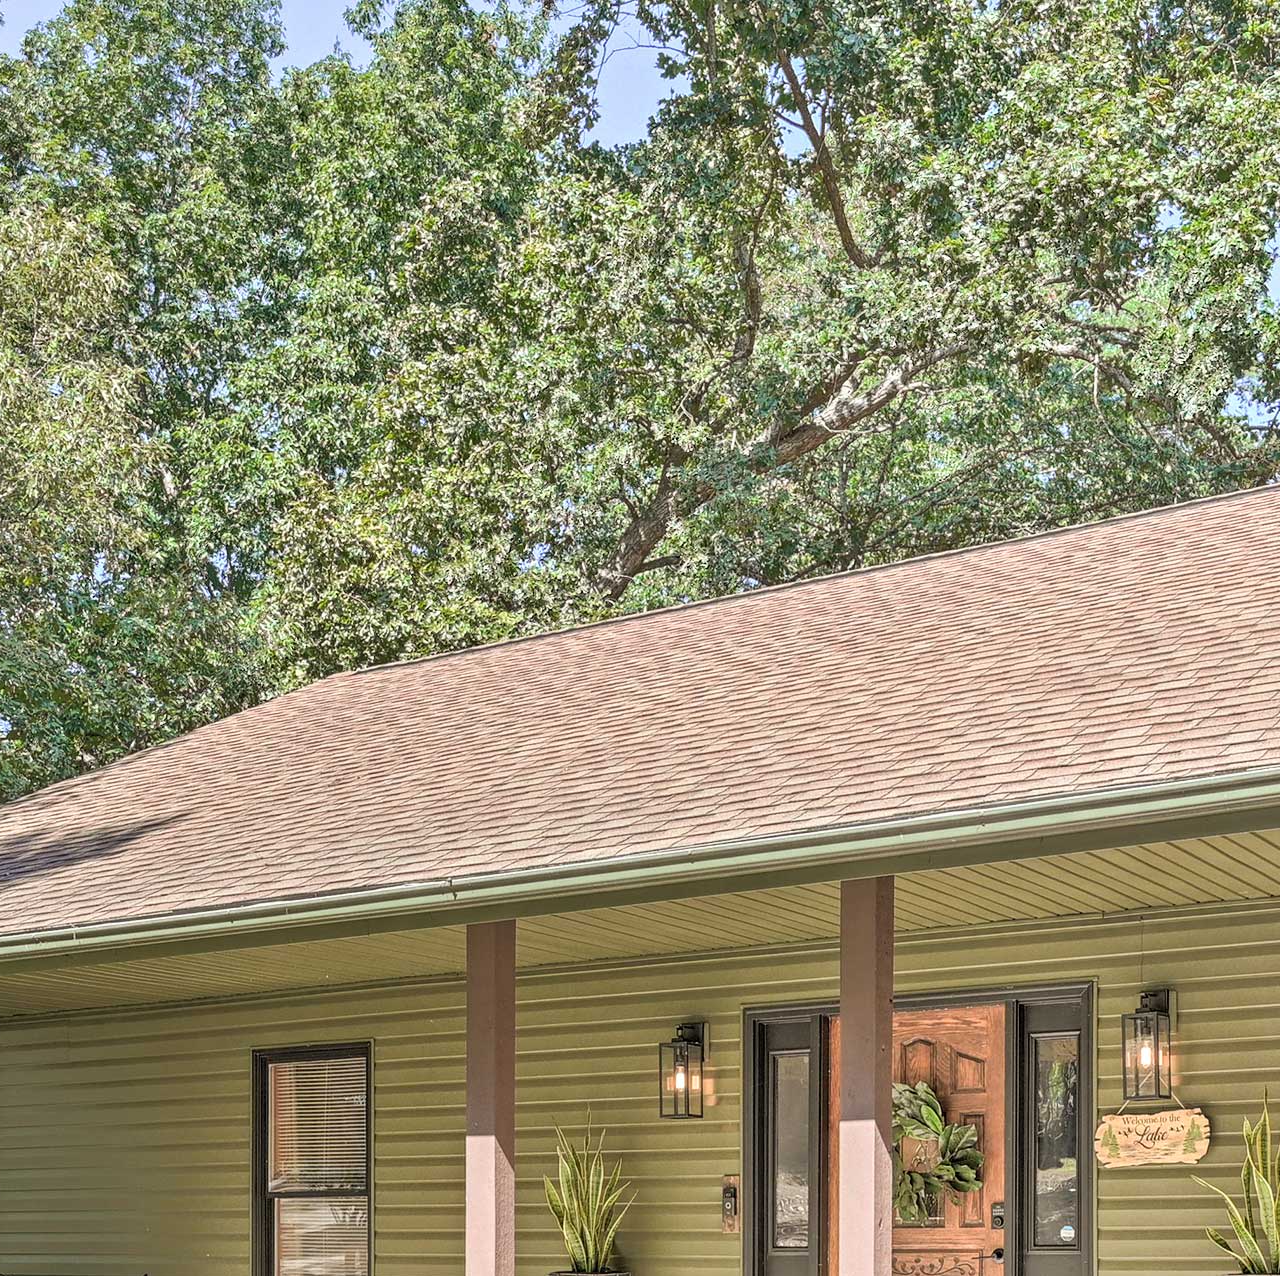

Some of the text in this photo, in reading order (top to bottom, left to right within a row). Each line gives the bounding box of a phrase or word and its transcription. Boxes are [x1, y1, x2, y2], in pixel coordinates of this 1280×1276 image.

[1122, 1113, 1181, 1125] Welcome to the
[1133, 1124, 1169, 1149] Lake
